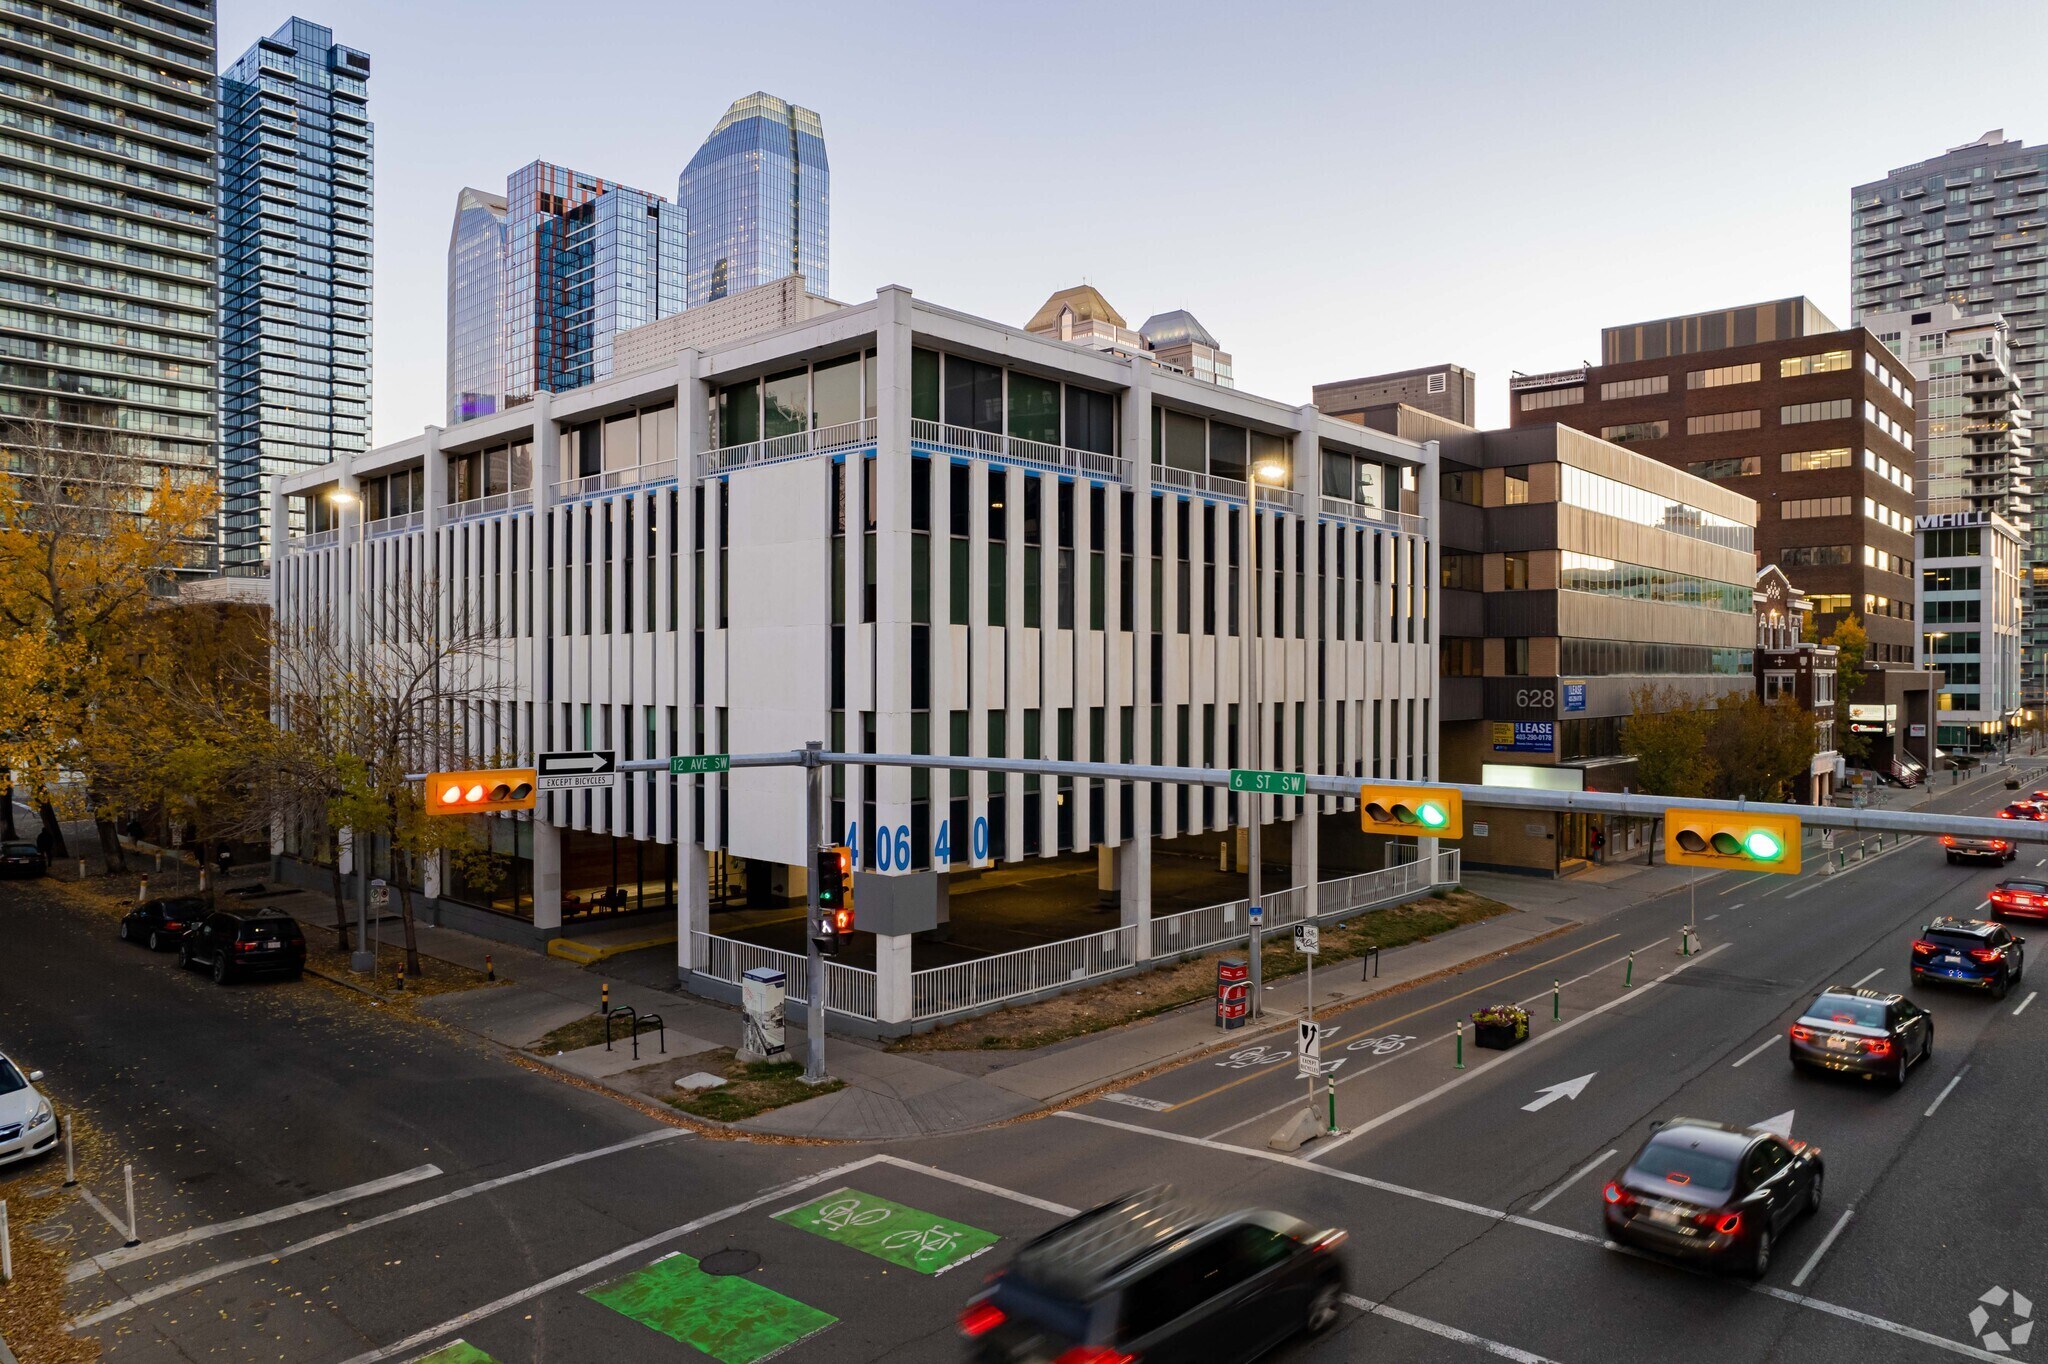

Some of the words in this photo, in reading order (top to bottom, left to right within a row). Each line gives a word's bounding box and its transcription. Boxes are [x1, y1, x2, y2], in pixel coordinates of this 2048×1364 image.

[1516, 689, 1555, 708] 628
[1520, 723, 1552, 734] LEASE
[673, 759, 684, 771] 12
[690, 758, 708, 770] AVE
[714, 757, 728, 769] SW
[547, 777, 573, 787] EXCEPT
[575, 776, 606, 786] BICYCLES
[1235, 774, 1243, 788] 6
[1256, 774, 1271, 789] ST
[1282, 776, 1300, 792] SW
[1302, 1058, 1317, 1066] EXCEPT
